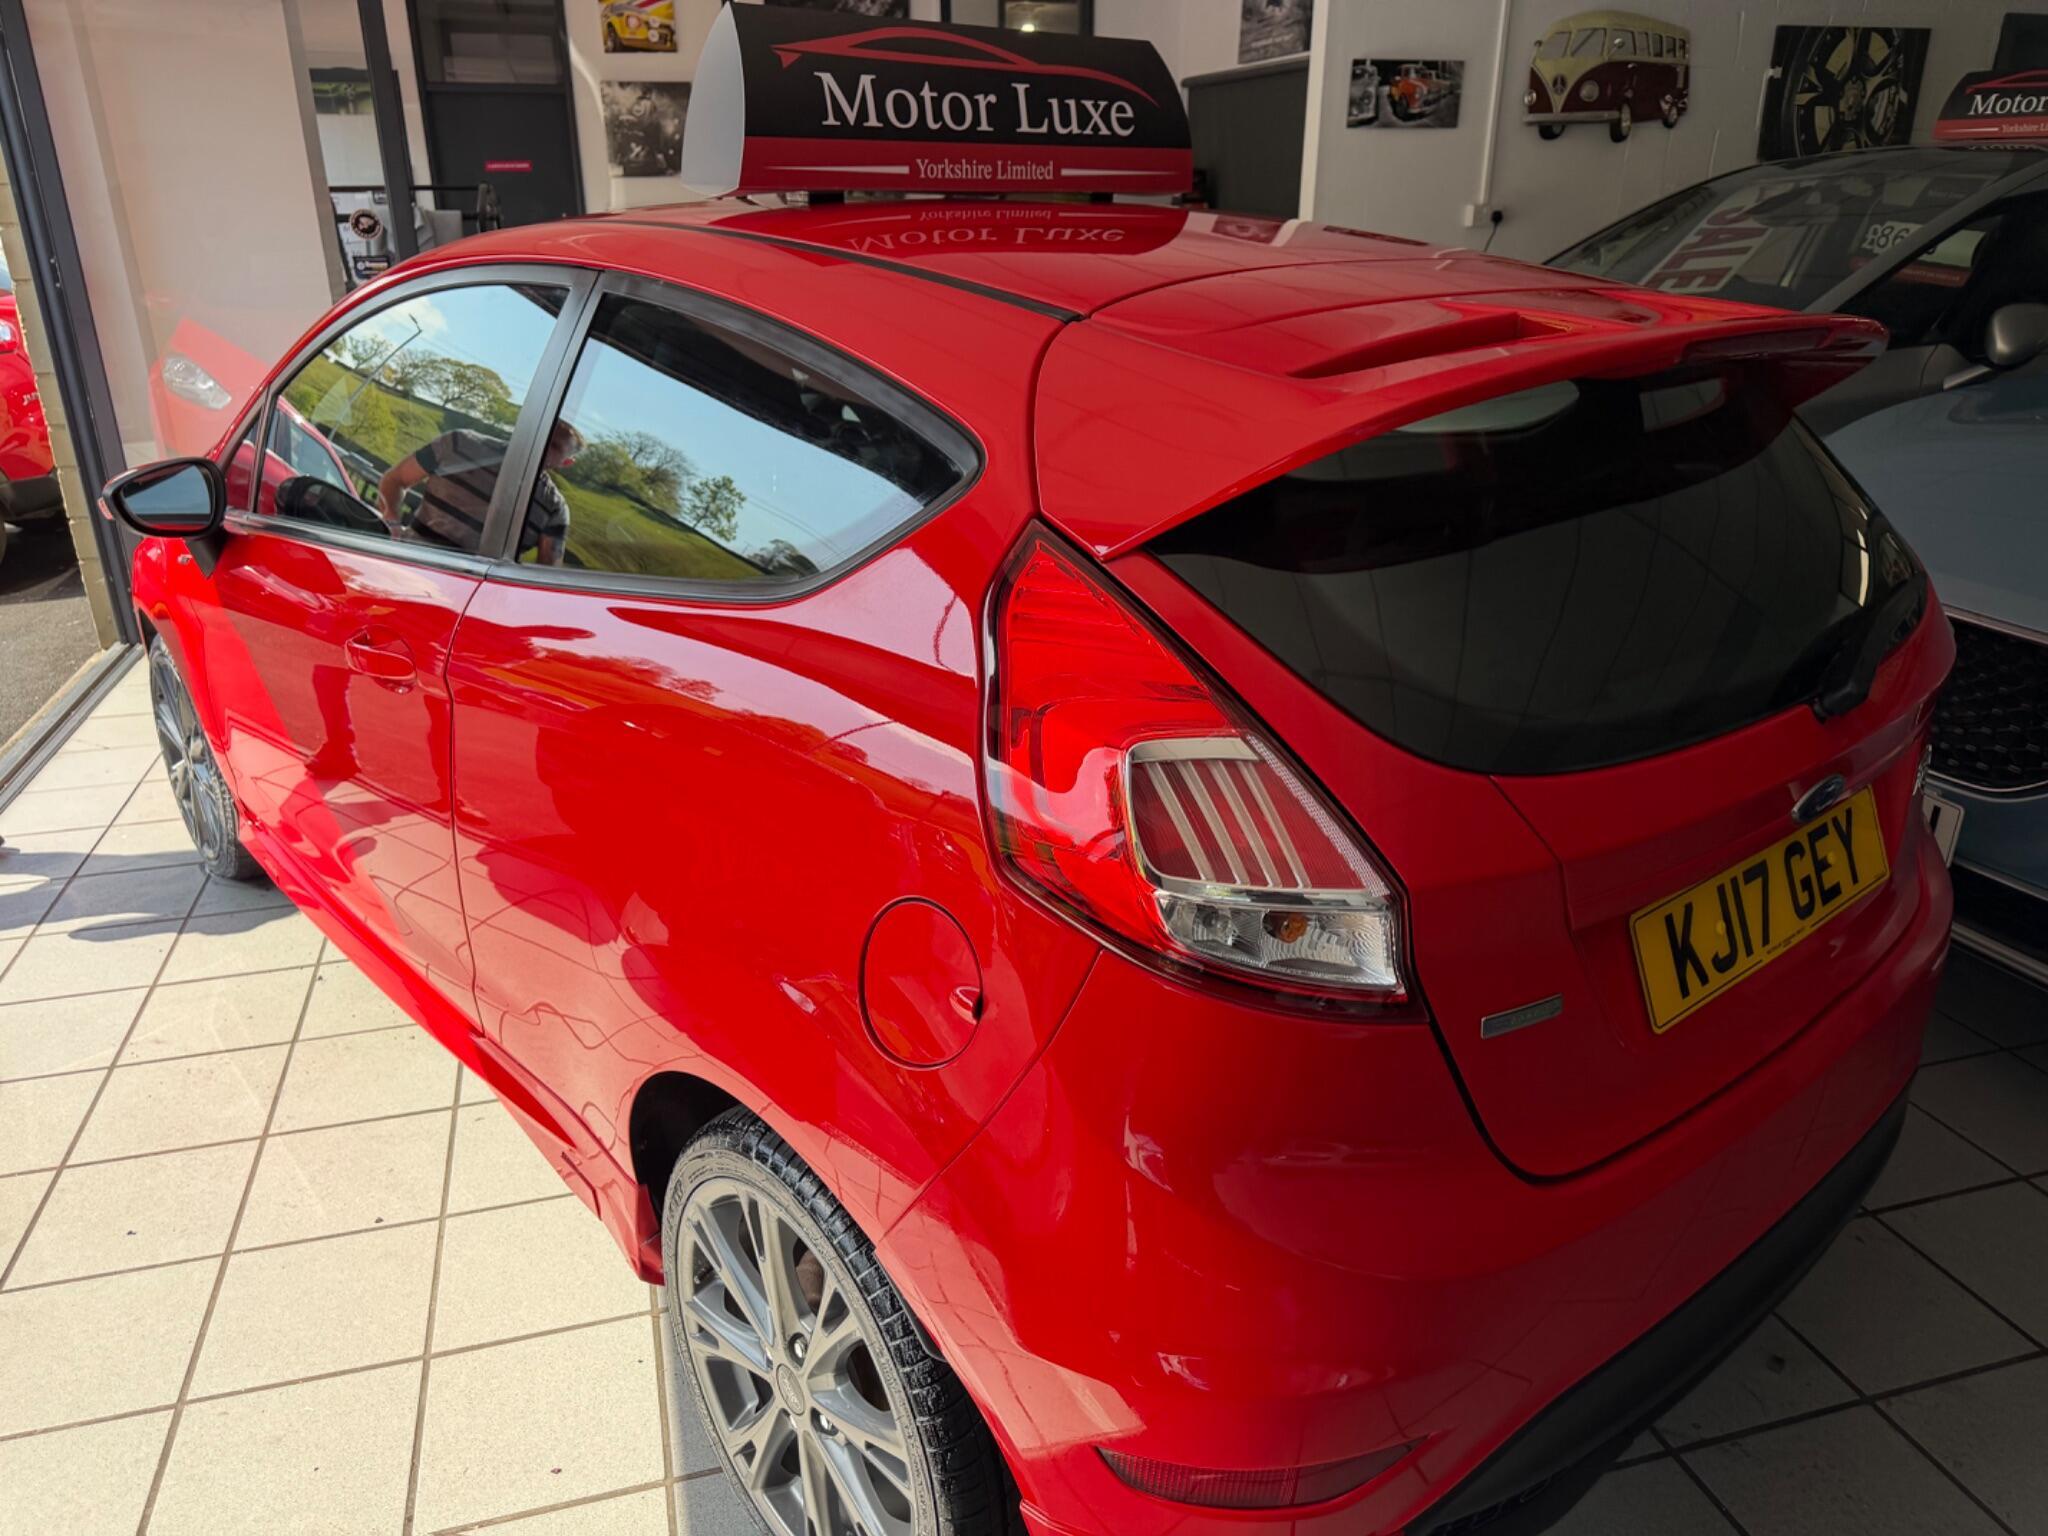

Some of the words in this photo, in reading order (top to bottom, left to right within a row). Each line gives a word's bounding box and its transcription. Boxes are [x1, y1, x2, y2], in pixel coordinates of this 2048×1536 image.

[813, 71, 997, 131] Motor
[1011, 82, 1135, 137] Luxe
[1968, 93, 2048, 115] Motor
[916, 158, 992, 180] Yorkshire
[996, 160, 1054, 180] Limited
[1664, 859, 1771, 1000] KJ17
[1783, 806, 1860, 921] GEY
